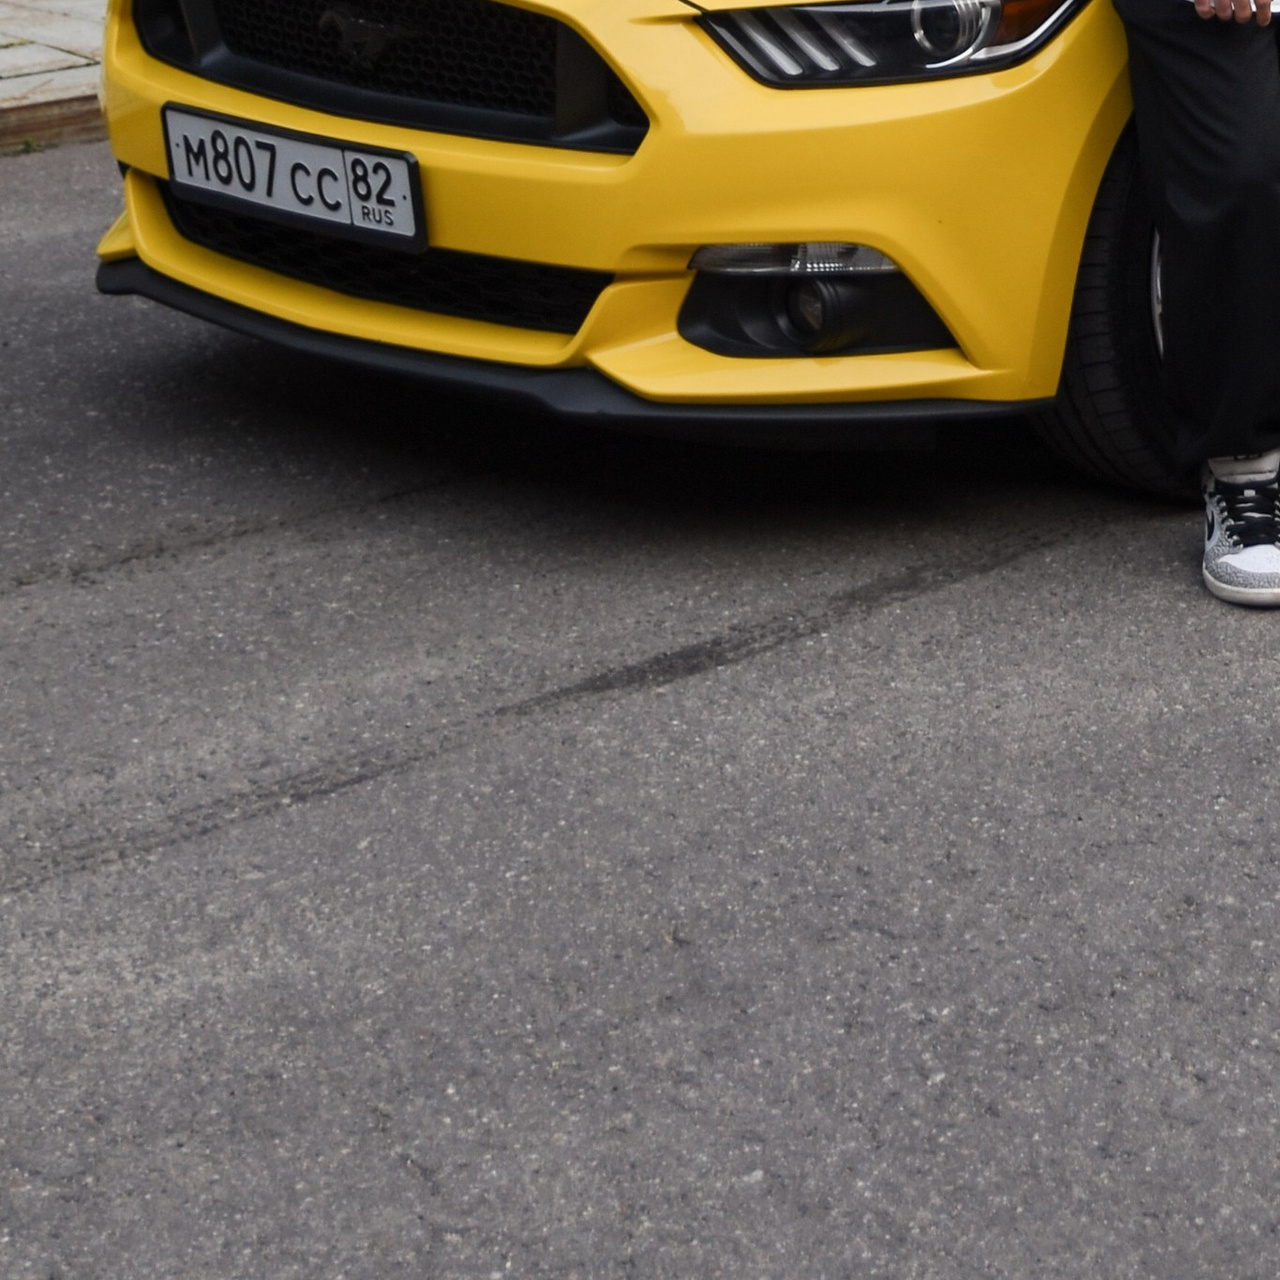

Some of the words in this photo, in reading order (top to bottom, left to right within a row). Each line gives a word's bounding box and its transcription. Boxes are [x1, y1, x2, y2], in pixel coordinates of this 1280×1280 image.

[183, 130, 277, 197] M807
[290, 162, 342, 211] CC
[351, 157, 396, 207] 82
[361, 205, 394, 226] RUS
